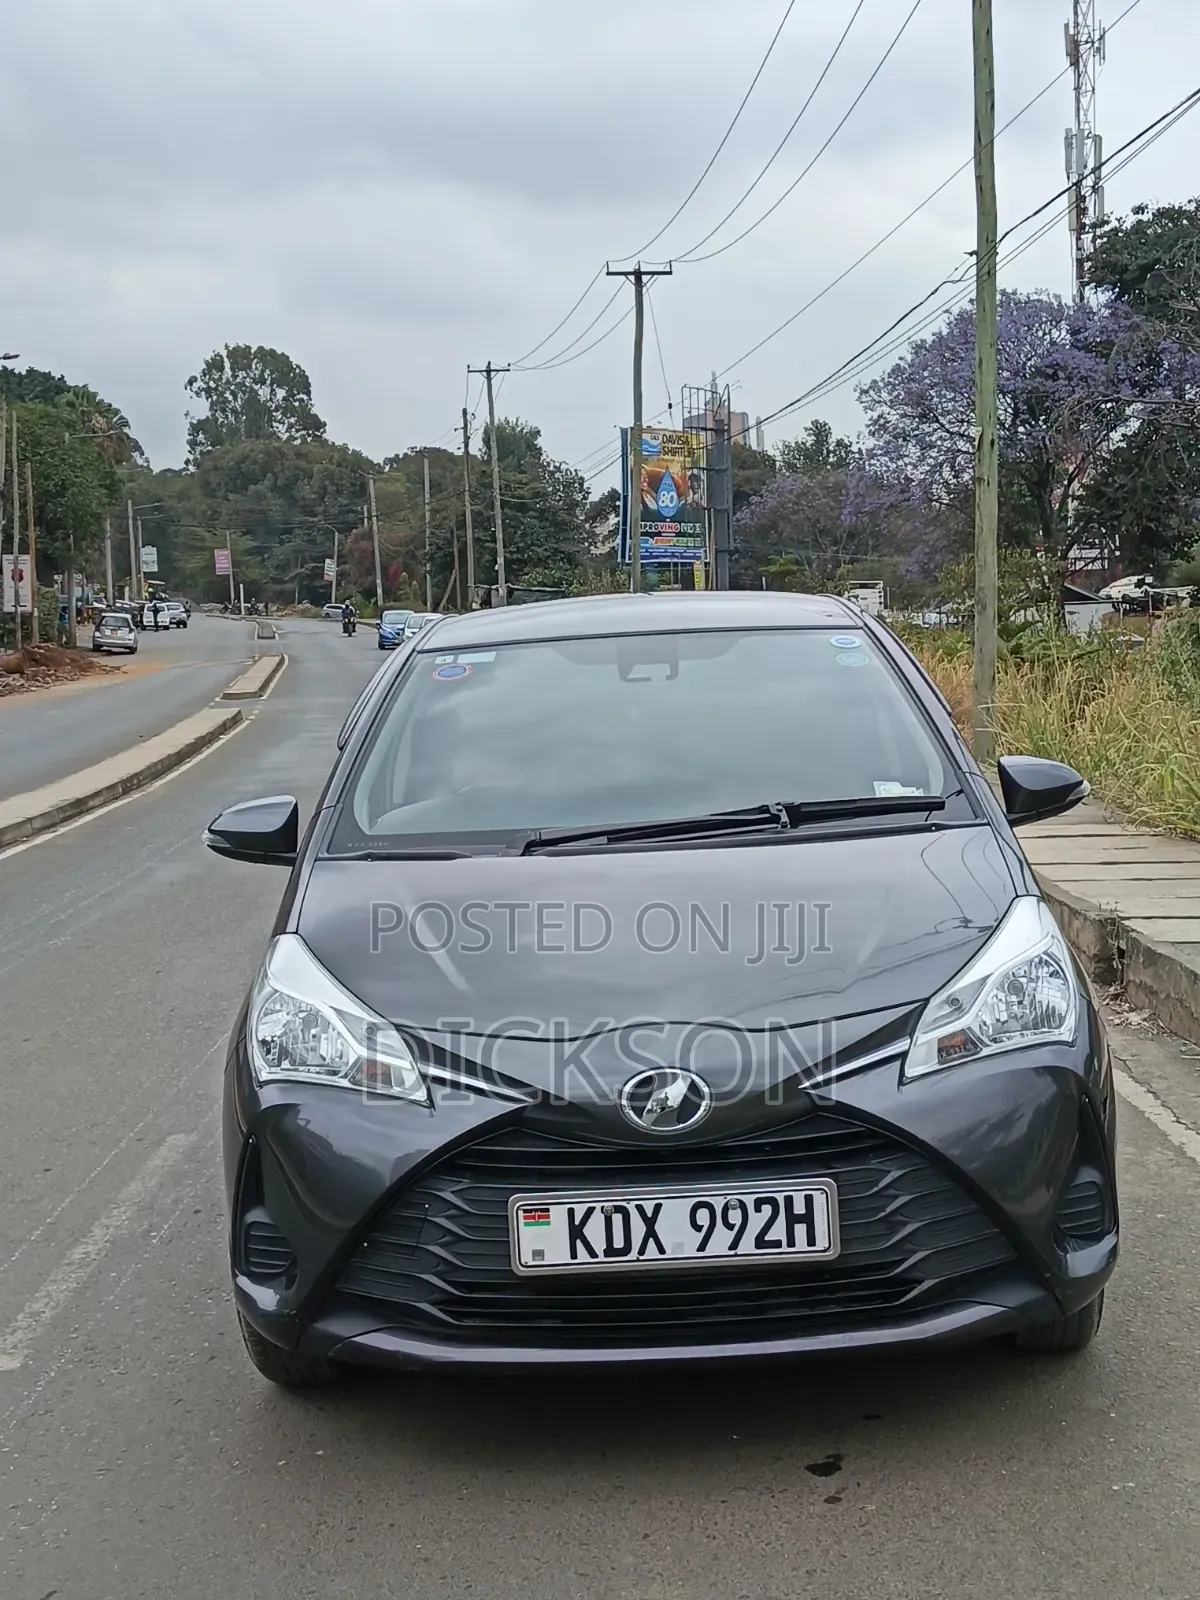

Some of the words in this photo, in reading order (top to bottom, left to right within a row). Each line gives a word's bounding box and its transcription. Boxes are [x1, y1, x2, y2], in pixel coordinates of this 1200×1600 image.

[658, 490, 677, 508] 80
[567, 1202, 666, 1260] KDX
[689, 1193, 817, 1253] 992H
